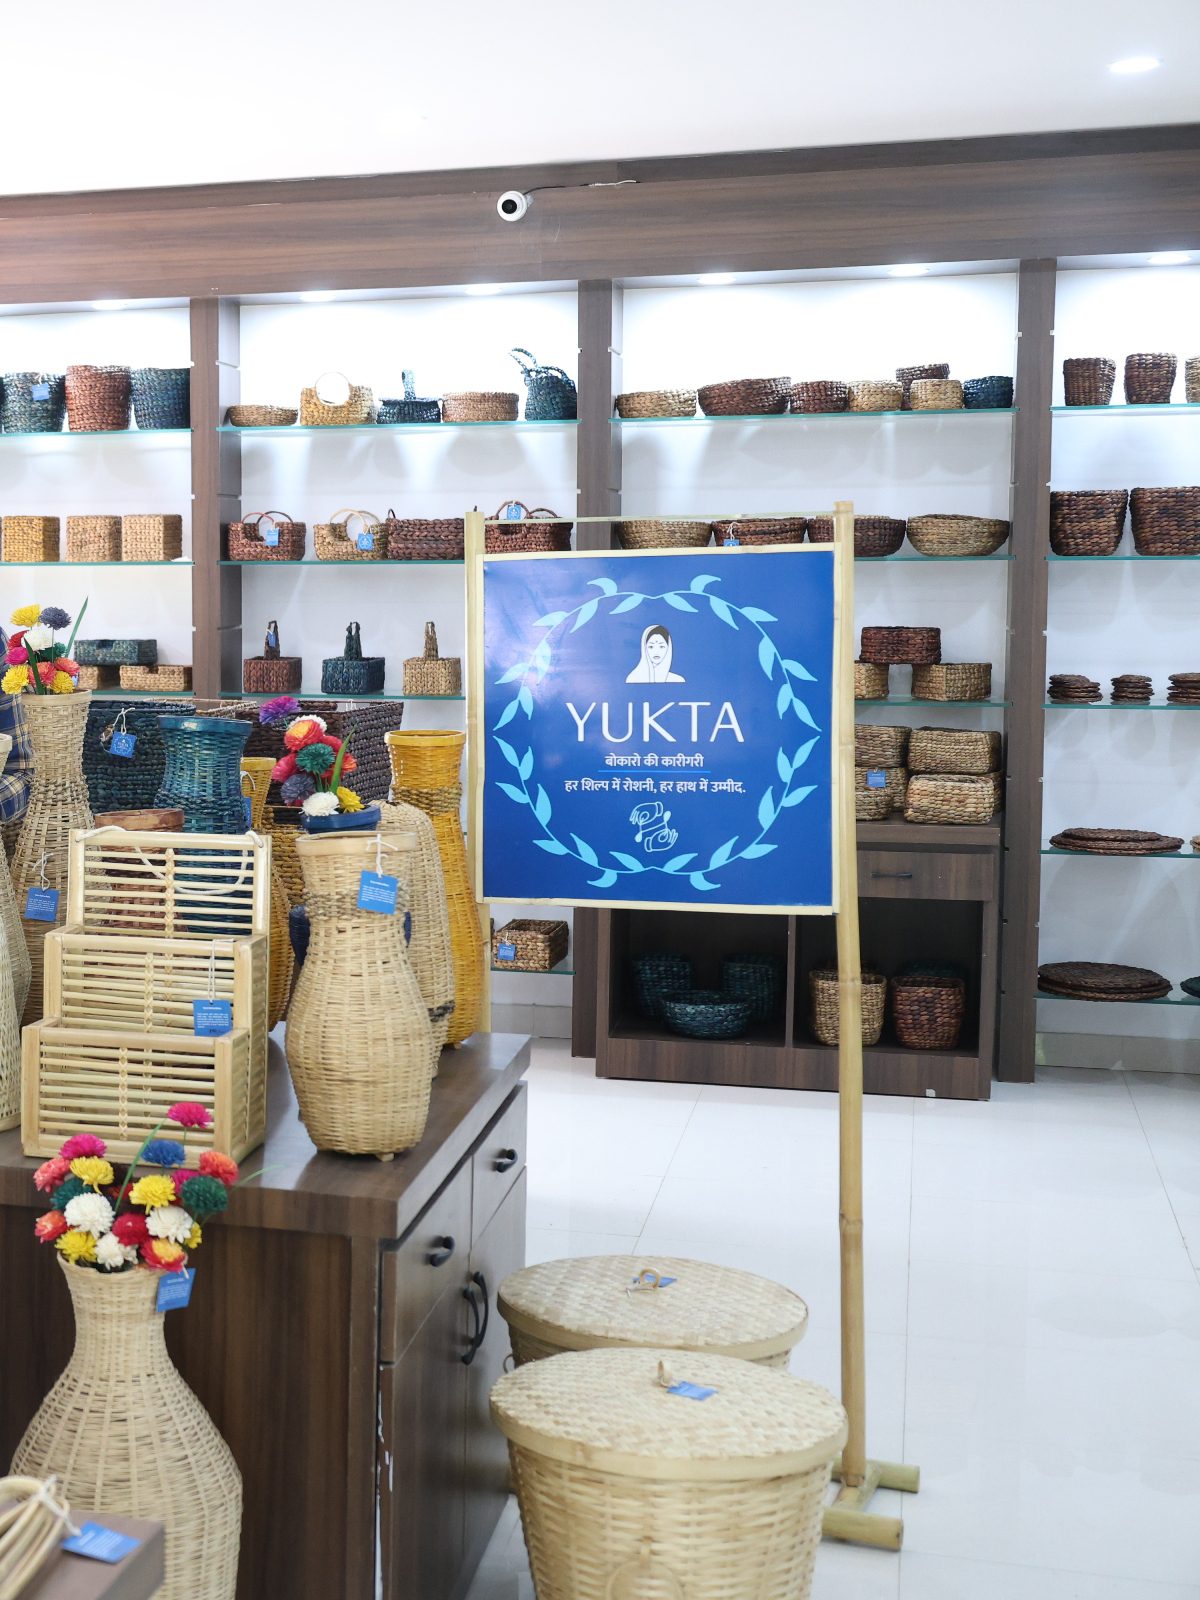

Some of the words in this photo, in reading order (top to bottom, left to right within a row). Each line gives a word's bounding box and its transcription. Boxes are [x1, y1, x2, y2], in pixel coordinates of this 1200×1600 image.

[565, 701, 745, 743] YUKTA
[604, 753, 641, 767] बोकारो
[643, 753, 659, 767] की
[661, 753, 704, 768] कारीगरी
[564, 779, 578, 793] हर
[581, 777, 609, 792] शिल्प
[611, 777, 622, 792] में
[623, 777, 657, 793] रोशनी,
[659, 779, 673, 793] हर
[676, 780, 696, 793] हाथ
[699, 778, 709, 793] में
[710, 778, 746, 794] उम्मीद.
